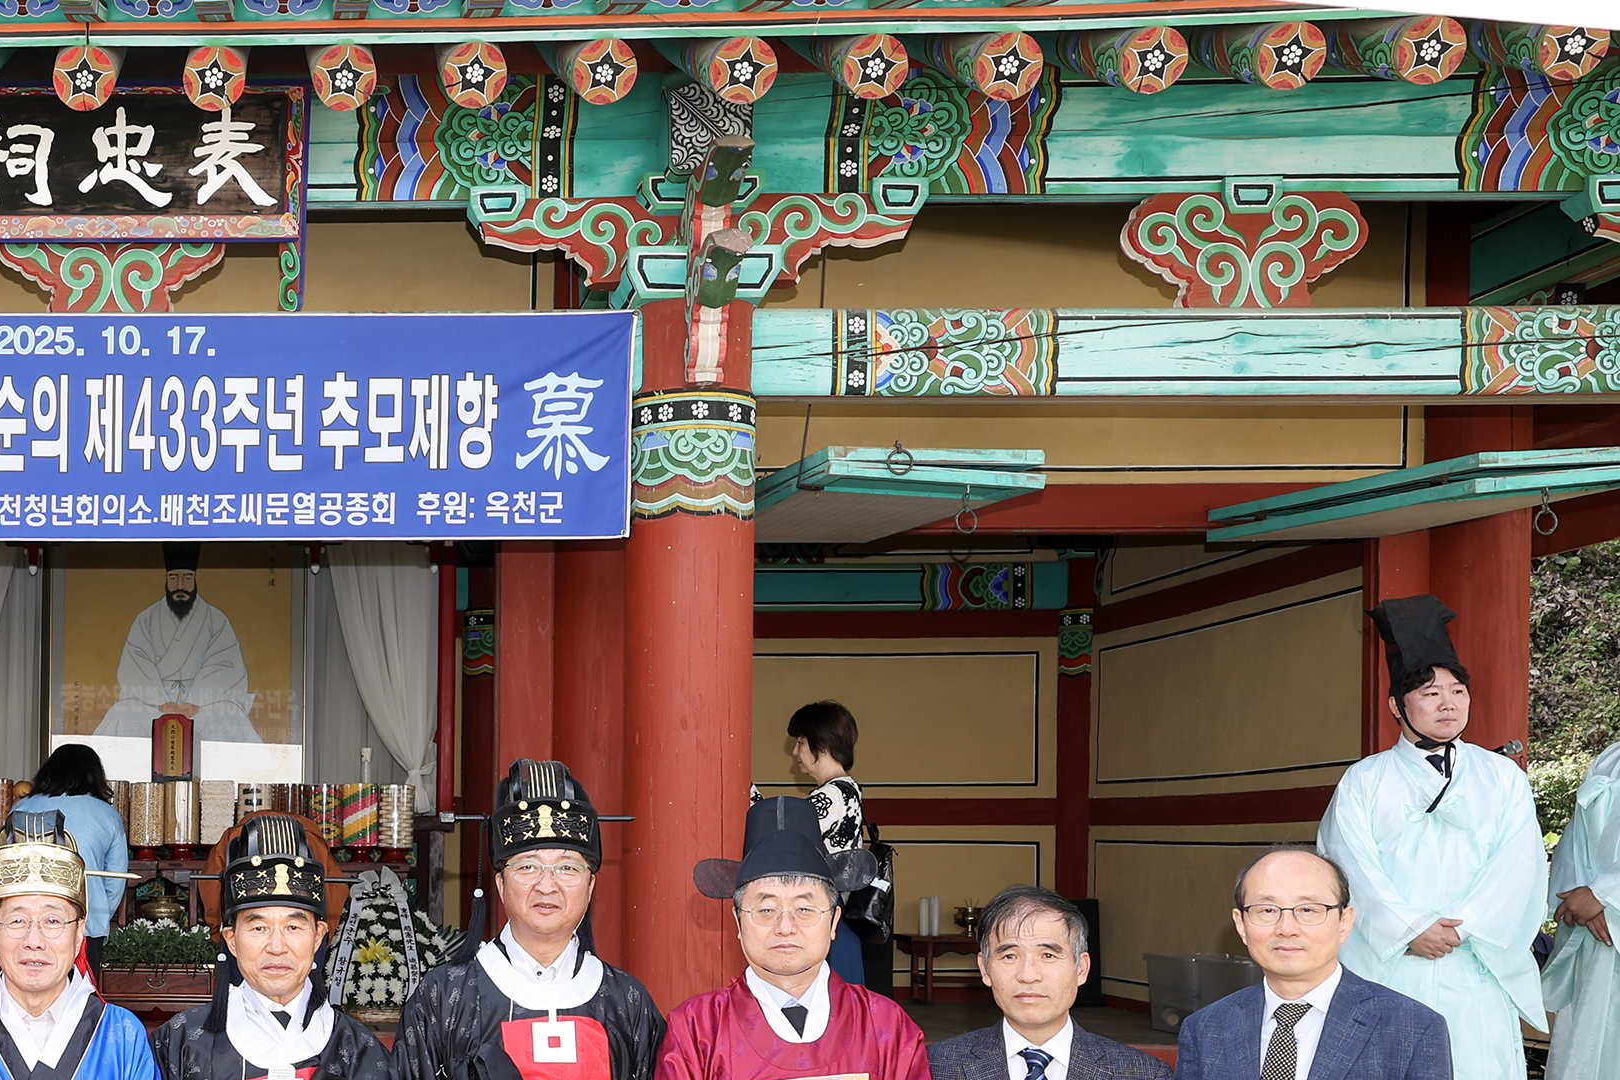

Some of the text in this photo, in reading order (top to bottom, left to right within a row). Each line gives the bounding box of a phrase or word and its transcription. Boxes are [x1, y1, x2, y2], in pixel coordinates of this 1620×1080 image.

[101, 325, 150, 357] 10.
[166, 325, 216, 357] 17.
[83, 374, 305, 474] 제433주년
[319, 371, 500, 471] 추모제향
[416, 491, 476, 525] 후원:
[485, 490, 564, 525] 옥천군
